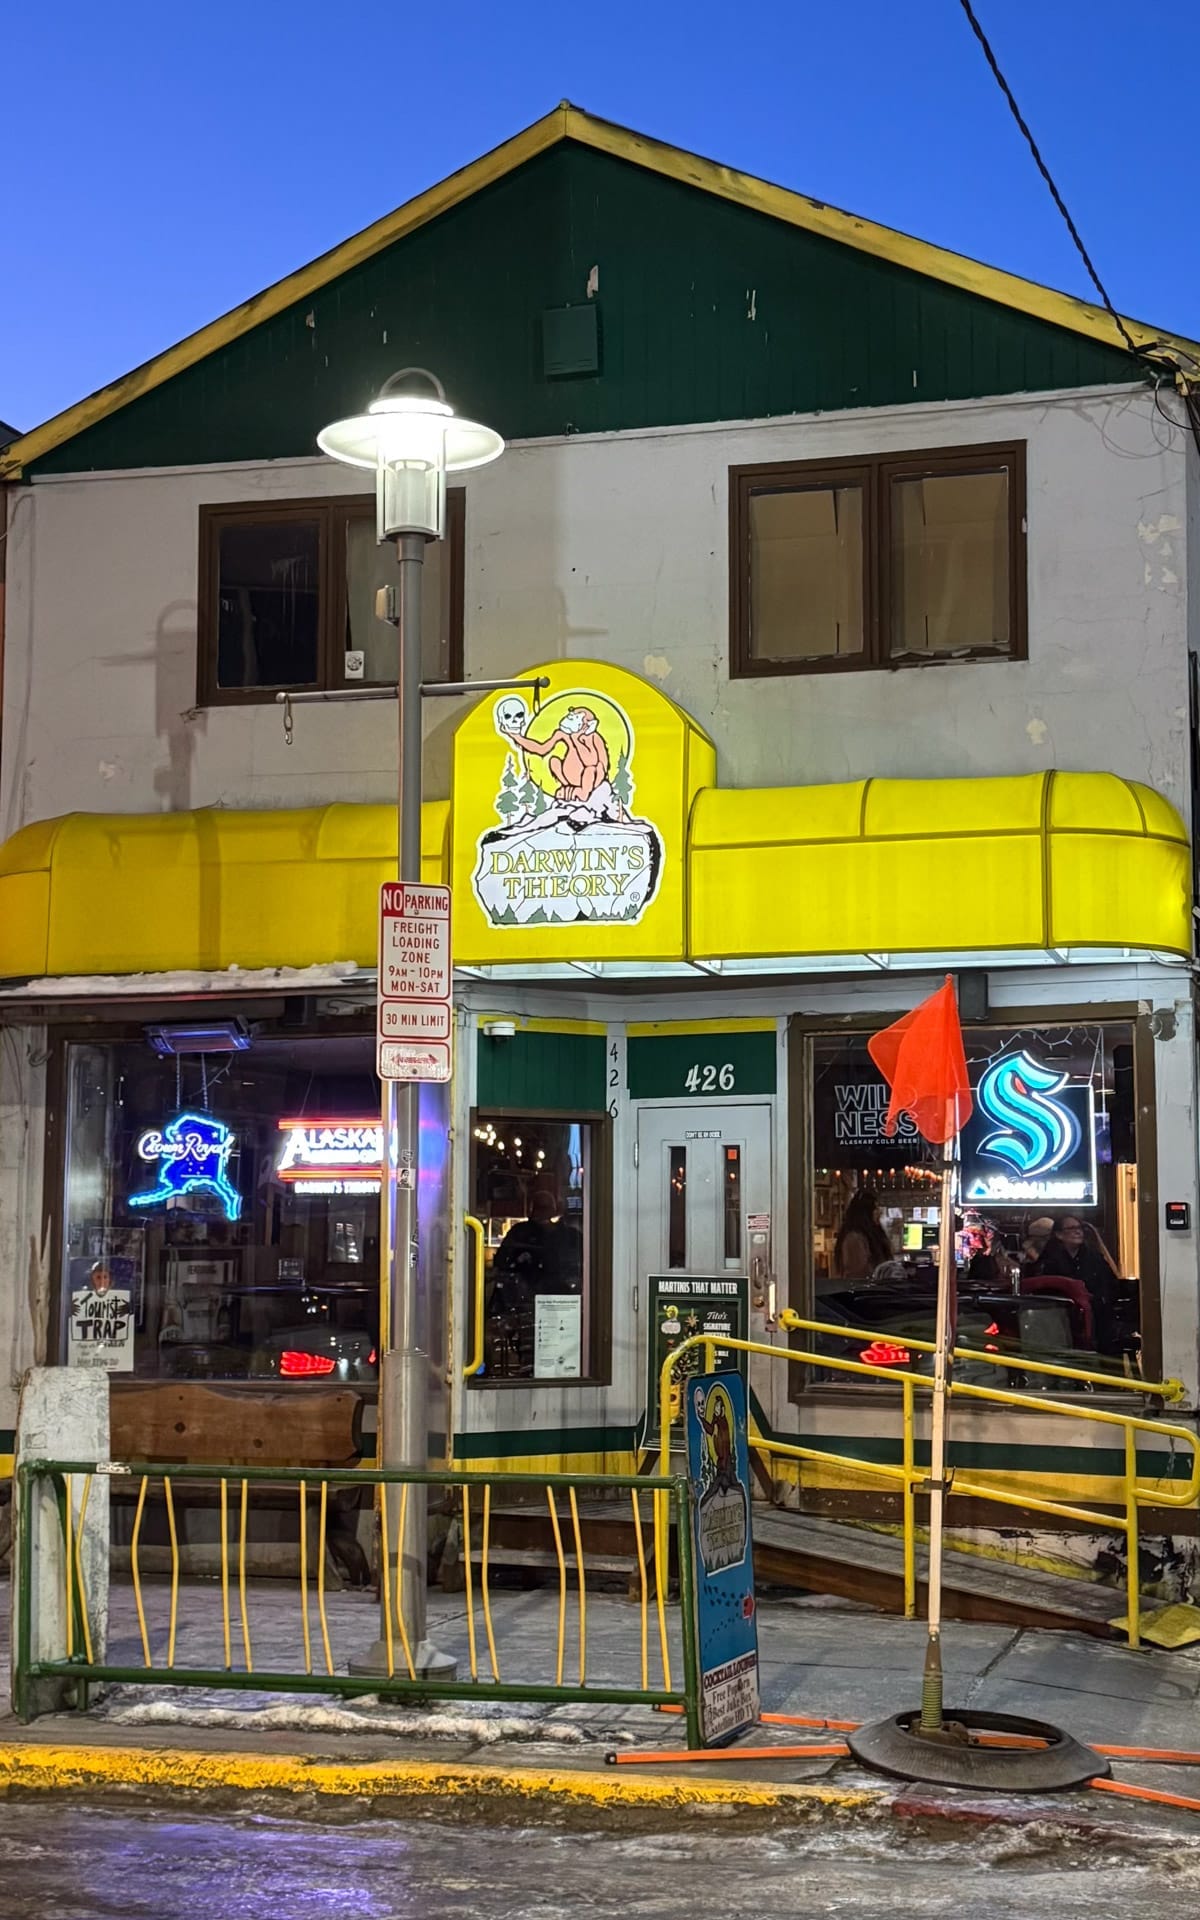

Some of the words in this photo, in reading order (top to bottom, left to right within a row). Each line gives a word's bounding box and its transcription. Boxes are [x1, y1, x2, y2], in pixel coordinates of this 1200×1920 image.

[490, 845, 645, 875] DARWIN'S
[503, 873, 631, 900] THEORY
[383, 889, 404, 911] NO
[404, 894, 449, 912] PARKING
[393, 921, 439, 935] FREIGHT
[392, 935, 440, 950] LOADING
[401, 951, 431, 964] ZONE
[388, 965, 408, 978] 9AM
[419, 967, 444, 979] 10PM
[391, 980, 441, 993] MON-SAT
[386, 1013, 398, 1025] 30
[401, 1014, 418, 1026] MIN
[421, 1015, 445, 1027] LIMIT
[684, 1063, 736, 1093] 426
[835, 1110, 919, 1138] NESS
[138, 1130, 184, 1161] Crown
[179, 1132, 236, 1161] Royal
[658, 1281, 690, 1293] MARTINIS
[692, 1281, 709, 1294] THAT
[710, 1282, 738, 1294] MATTER
[80, 1292, 121, 1320] Tourist
[706, 1311, 728, 1320] Tito's
[76, 1319, 126, 1340] TRAP
[703, 1664, 732, 1690] COCKTAIL
[712, 1690, 726, 1705] Free
